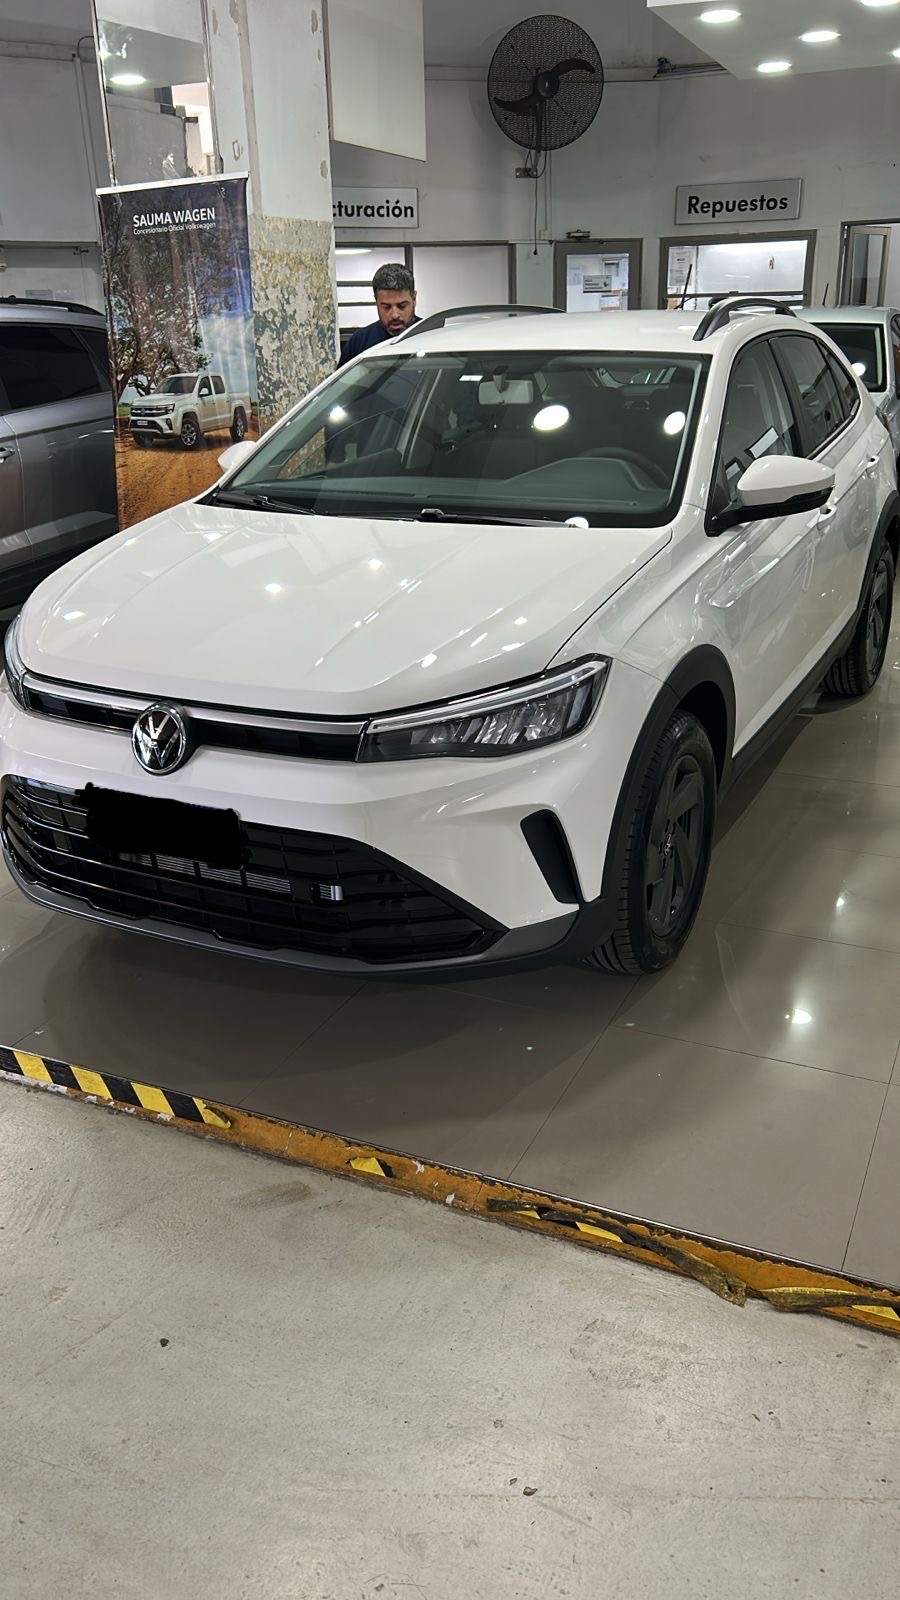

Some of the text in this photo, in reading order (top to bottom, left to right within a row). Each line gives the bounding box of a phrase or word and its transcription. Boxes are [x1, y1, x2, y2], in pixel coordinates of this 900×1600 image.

[687, 194, 788, 218] Repuestos
[133, 207, 216, 228] SAUMA WAGEN
[133, 222, 217, 235] Concesionario Oficial Volkswagen
